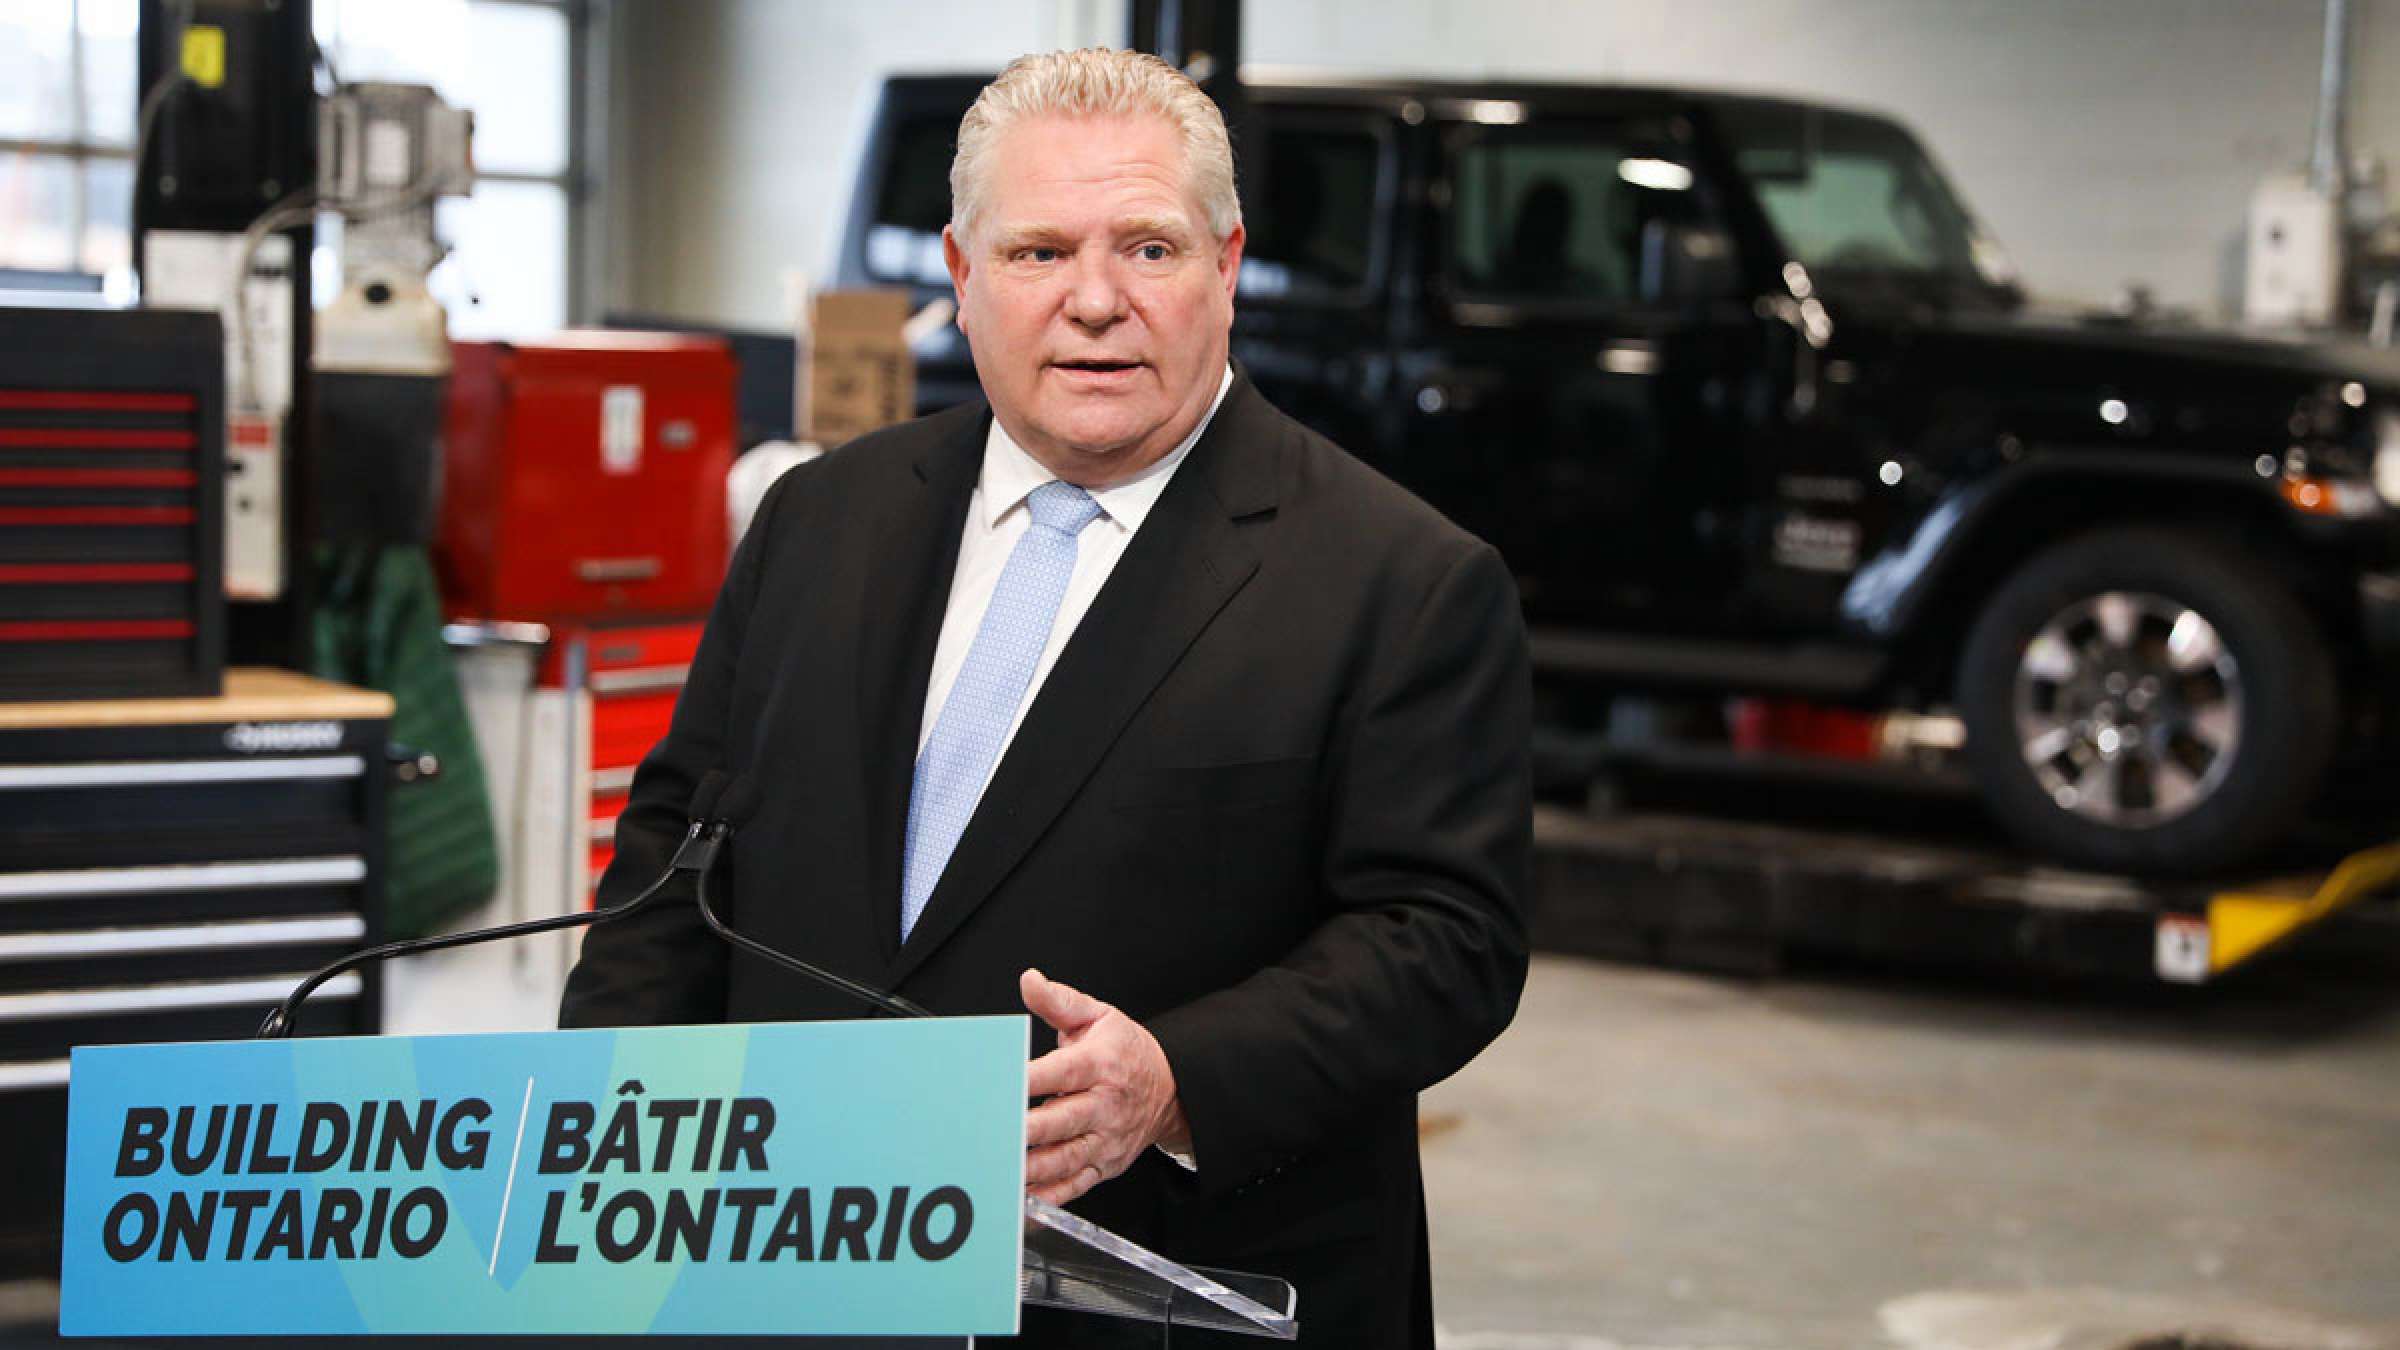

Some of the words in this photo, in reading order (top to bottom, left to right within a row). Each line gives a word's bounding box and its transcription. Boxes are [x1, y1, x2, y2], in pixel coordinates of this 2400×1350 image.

[115, 1097, 493, 1177] BUILDING
[537, 1079, 776, 1175] BÂTIR
[103, 1187, 449, 1263] ONTARIO
